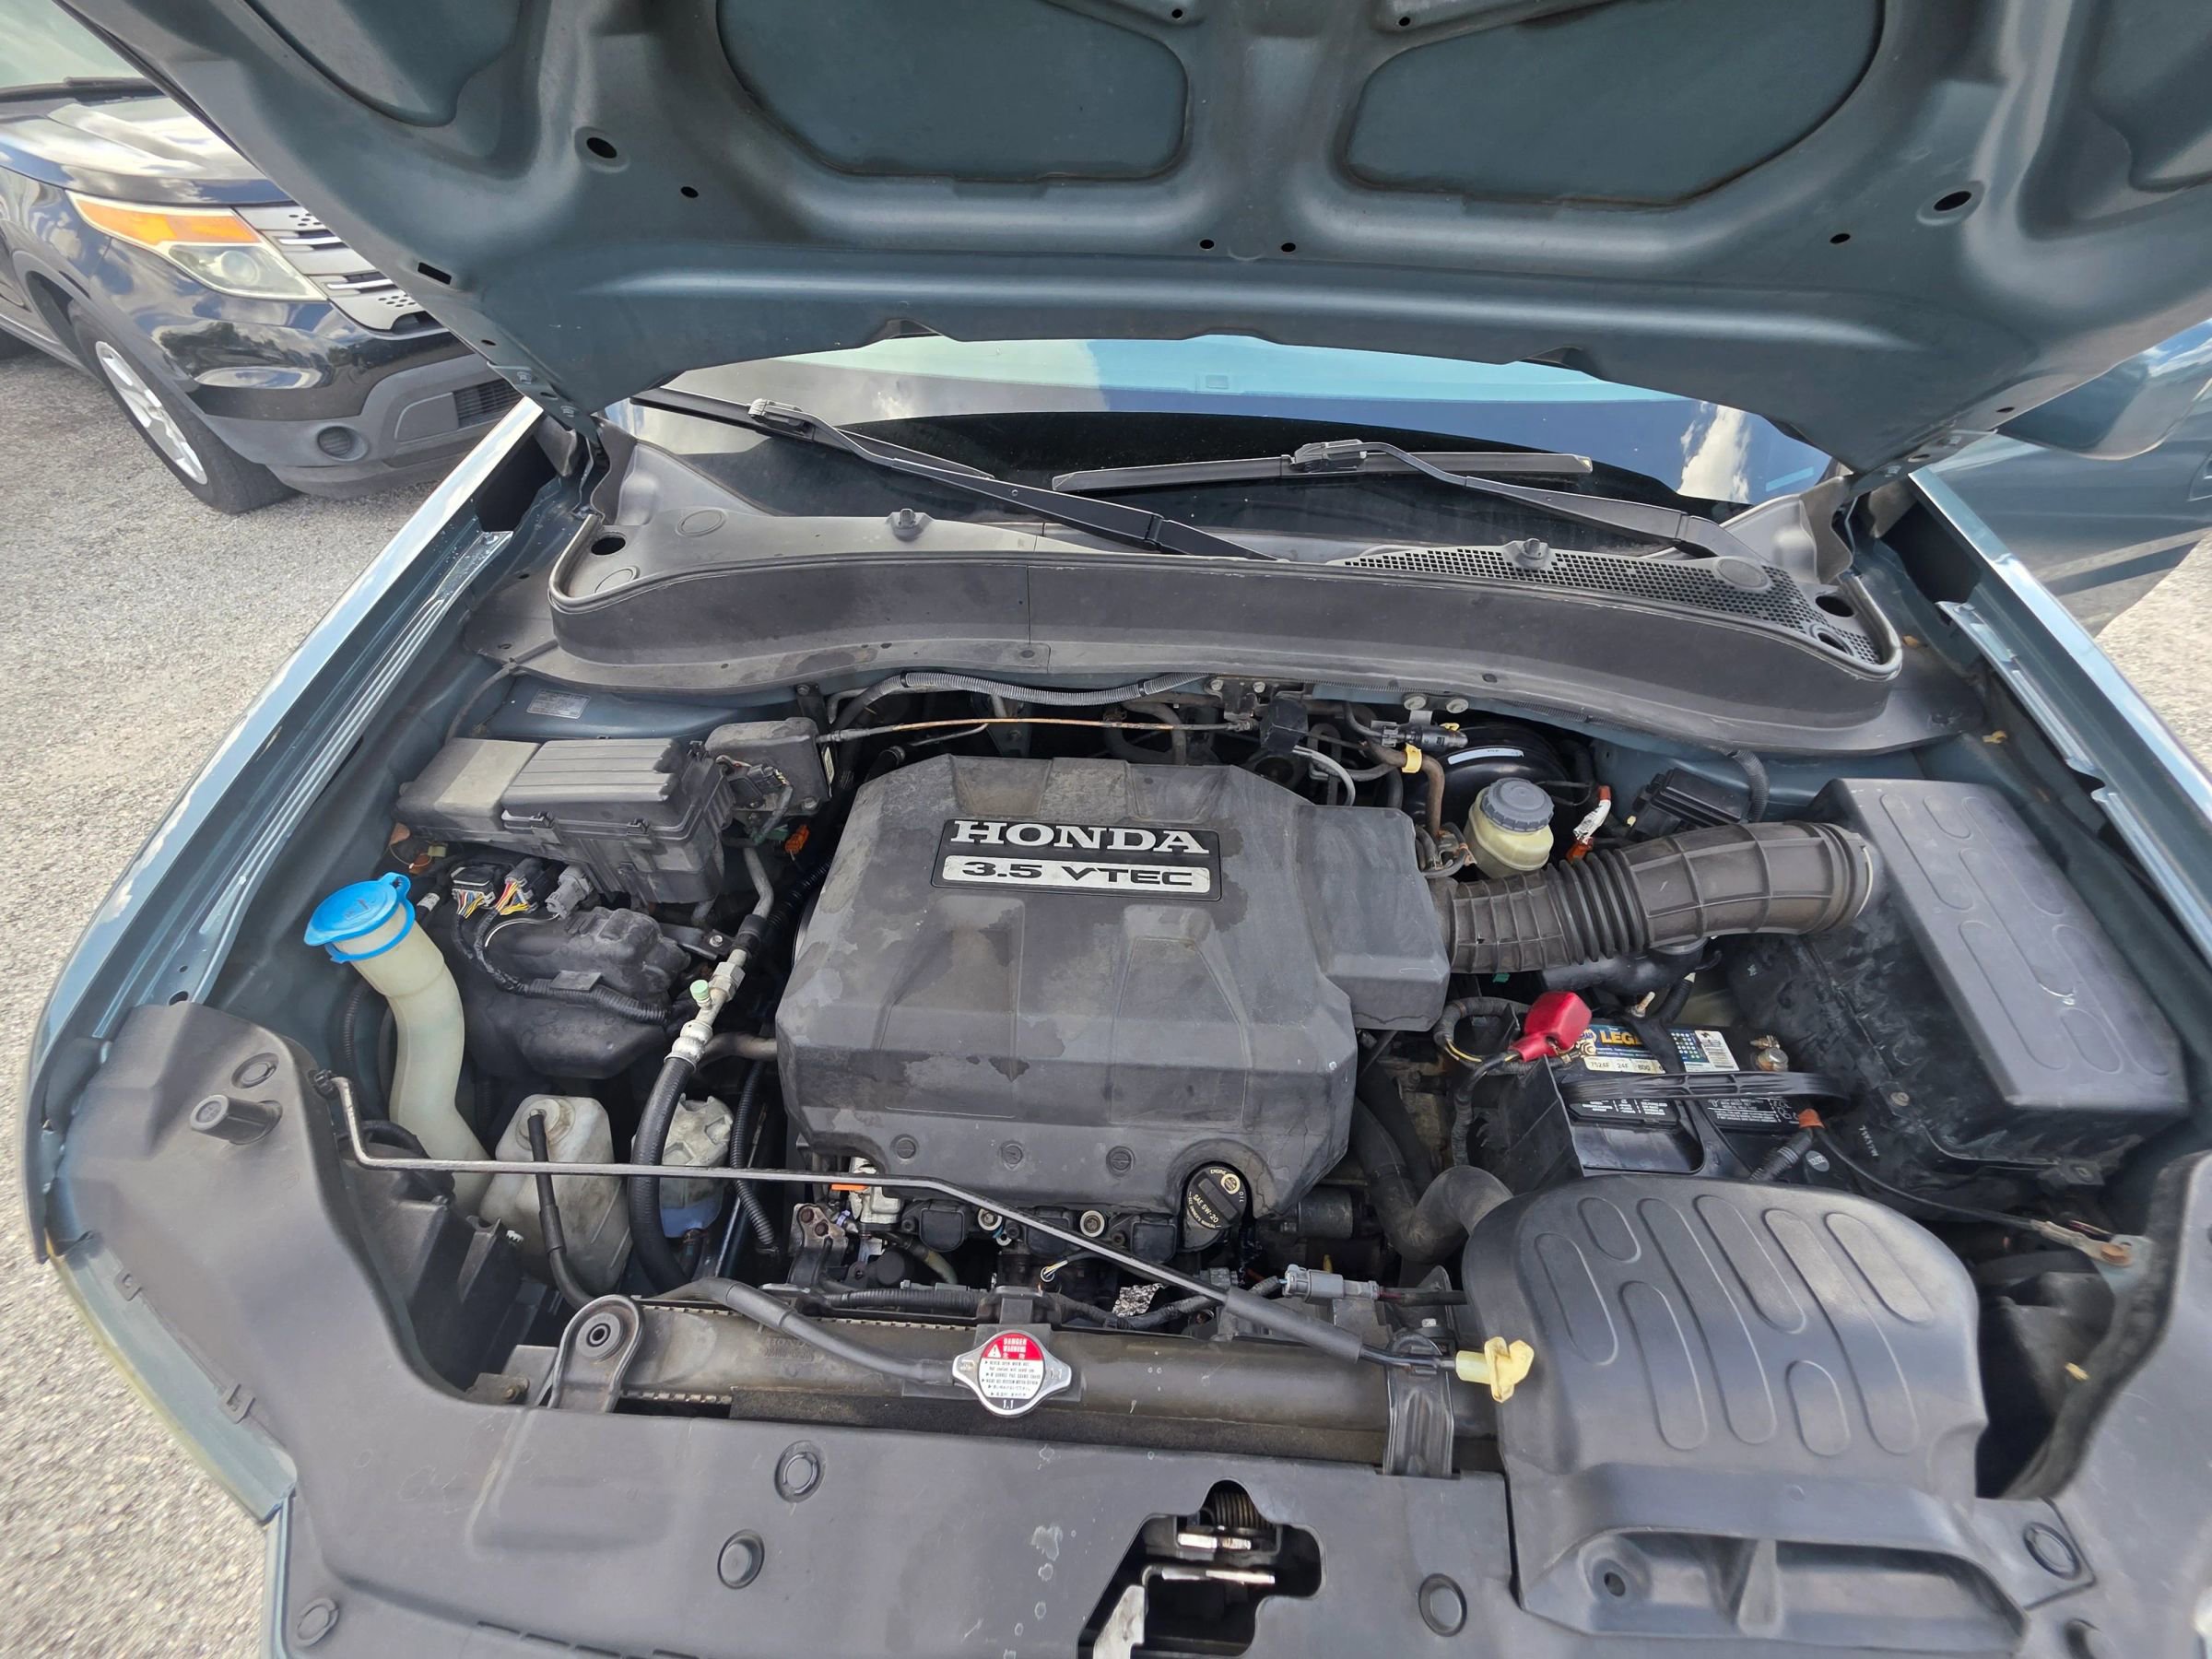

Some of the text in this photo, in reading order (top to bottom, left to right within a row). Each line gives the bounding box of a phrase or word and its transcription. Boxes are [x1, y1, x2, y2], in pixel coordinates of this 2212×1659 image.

[951, 820, 1209, 854] HONDA
[962, 862, 1193, 887] 3.5 VTEC
[1193, 1194, 1204, 1206] SAE
[1003, 1337, 1027, 1346] DANGER
[1003, 1399, 1014, 1409] 1.1
